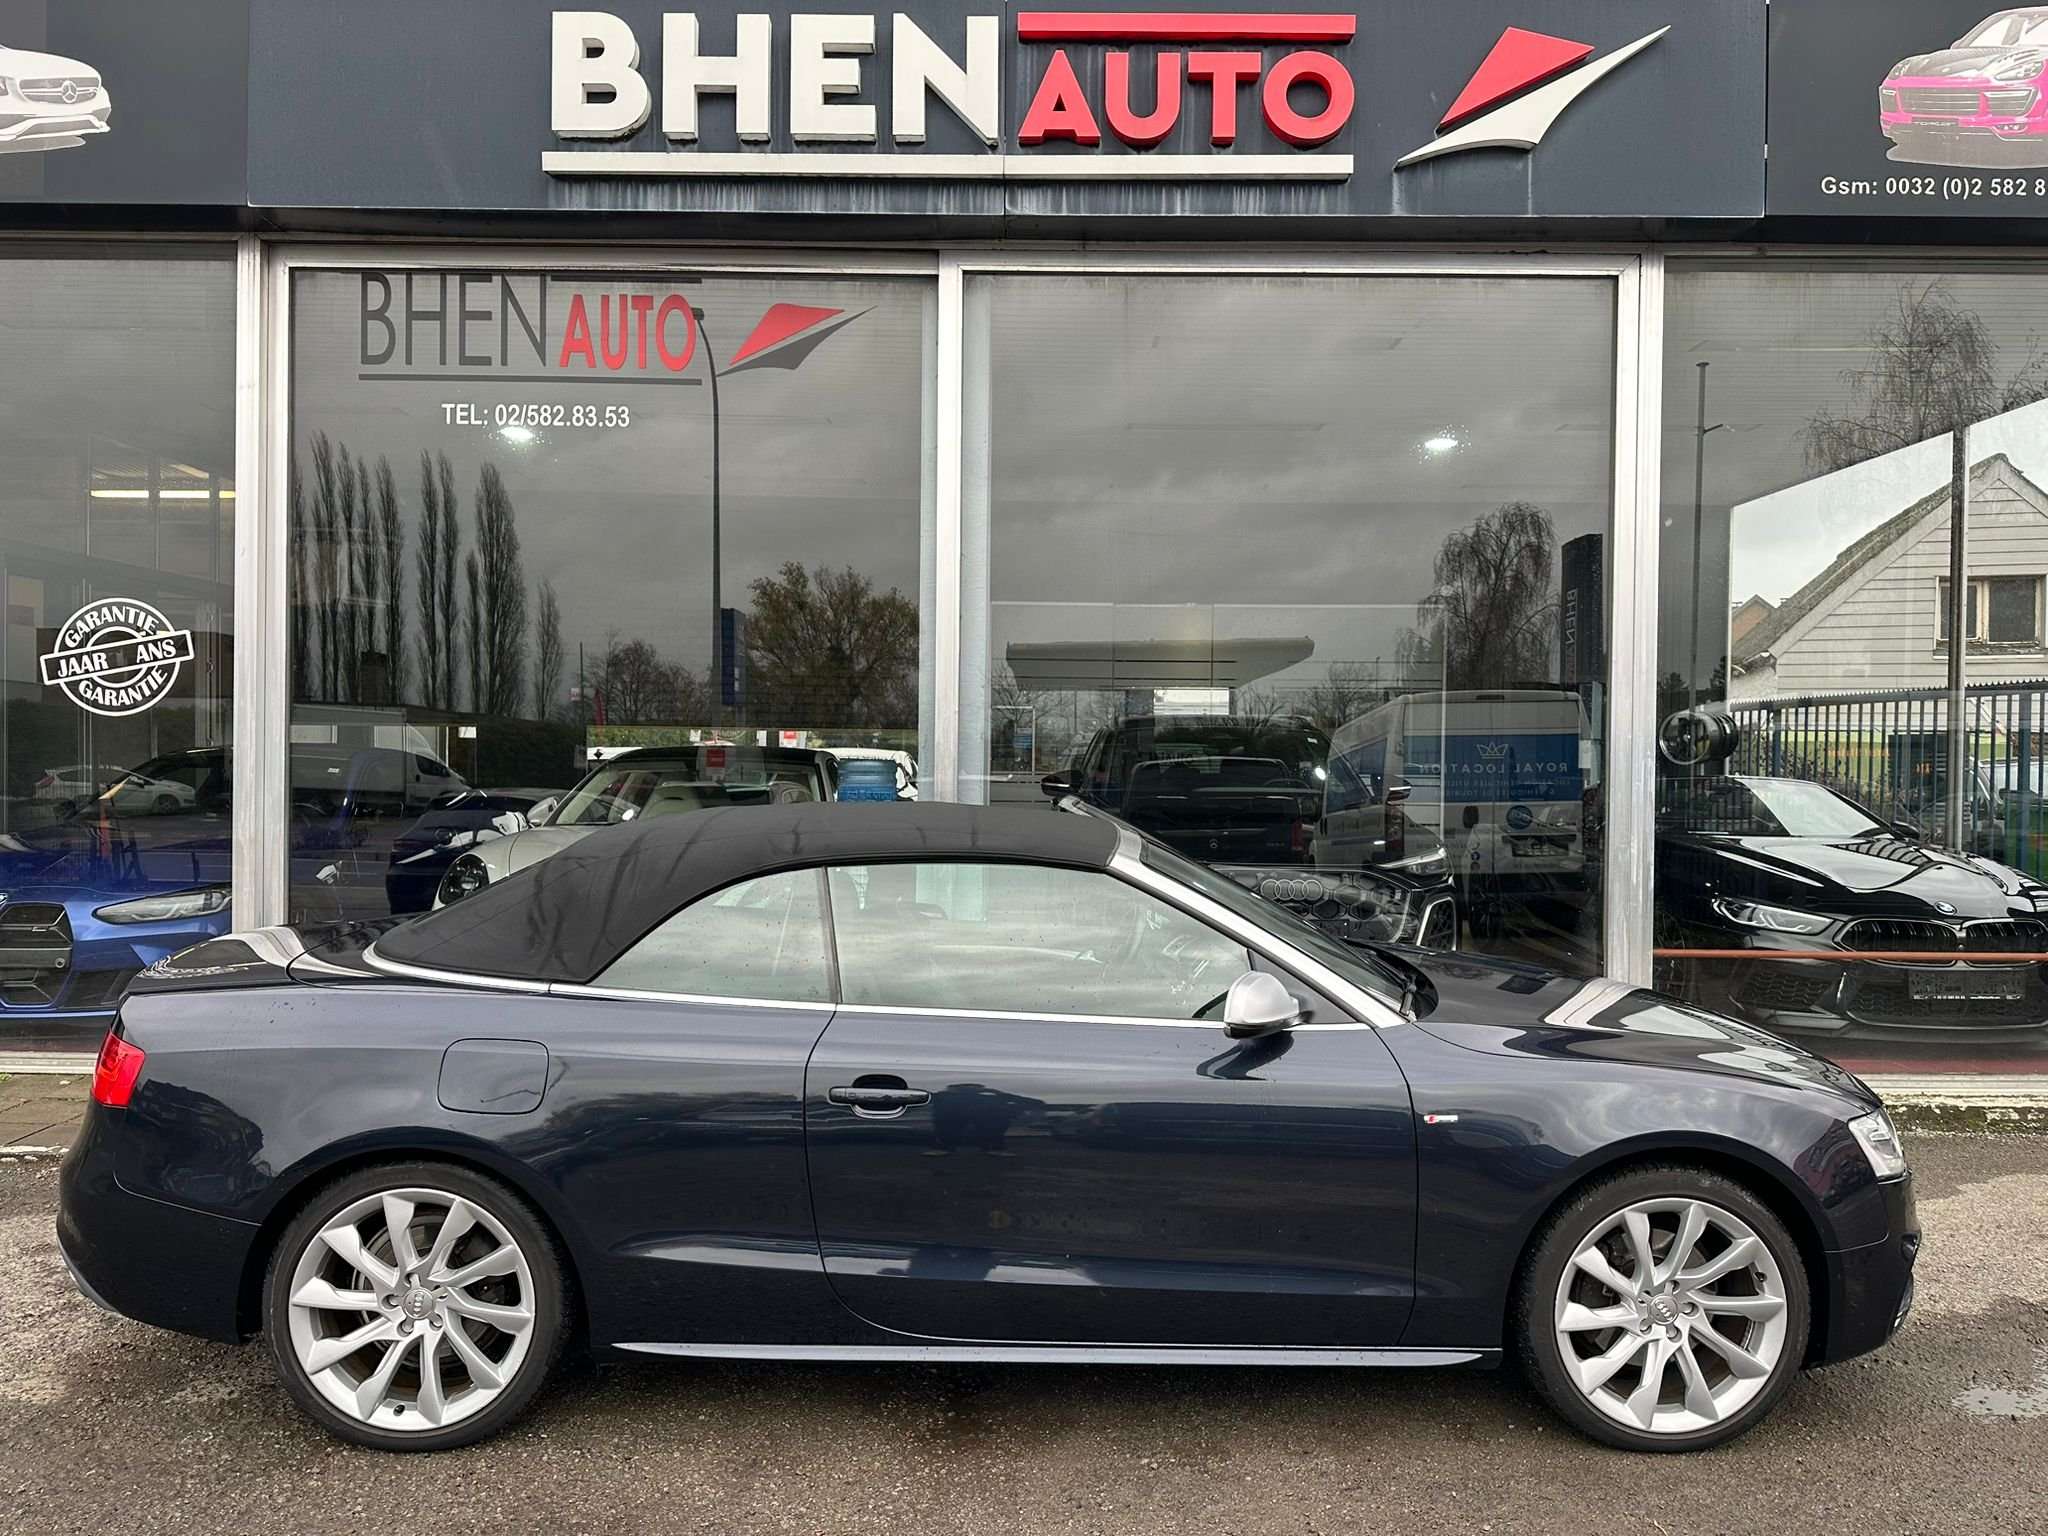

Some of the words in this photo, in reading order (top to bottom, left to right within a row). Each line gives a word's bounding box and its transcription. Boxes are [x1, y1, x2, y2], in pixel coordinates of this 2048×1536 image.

[550, 10, 1000, 146] BHEN
[1017, 49, 1356, 149] AUTO
[1821, 176, 1878, 195] Gsm:
[1885, 177, 1936, 195] 0032
[1943, 177, 1982, 200] (0)2
[1990, 178, 2027, 196] 582
[360, 272, 546, 366] BHEN
[559, 294, 697, 372] AUTO
[494, 404, 631, 427] 02/582.83.53
[64, 605, 160, 648] GARANTIE
[57, 652, 109, 677] JAAR
[136, 639, 177, 664] ANS
[78, 666, 168, 707] GARANTIE
